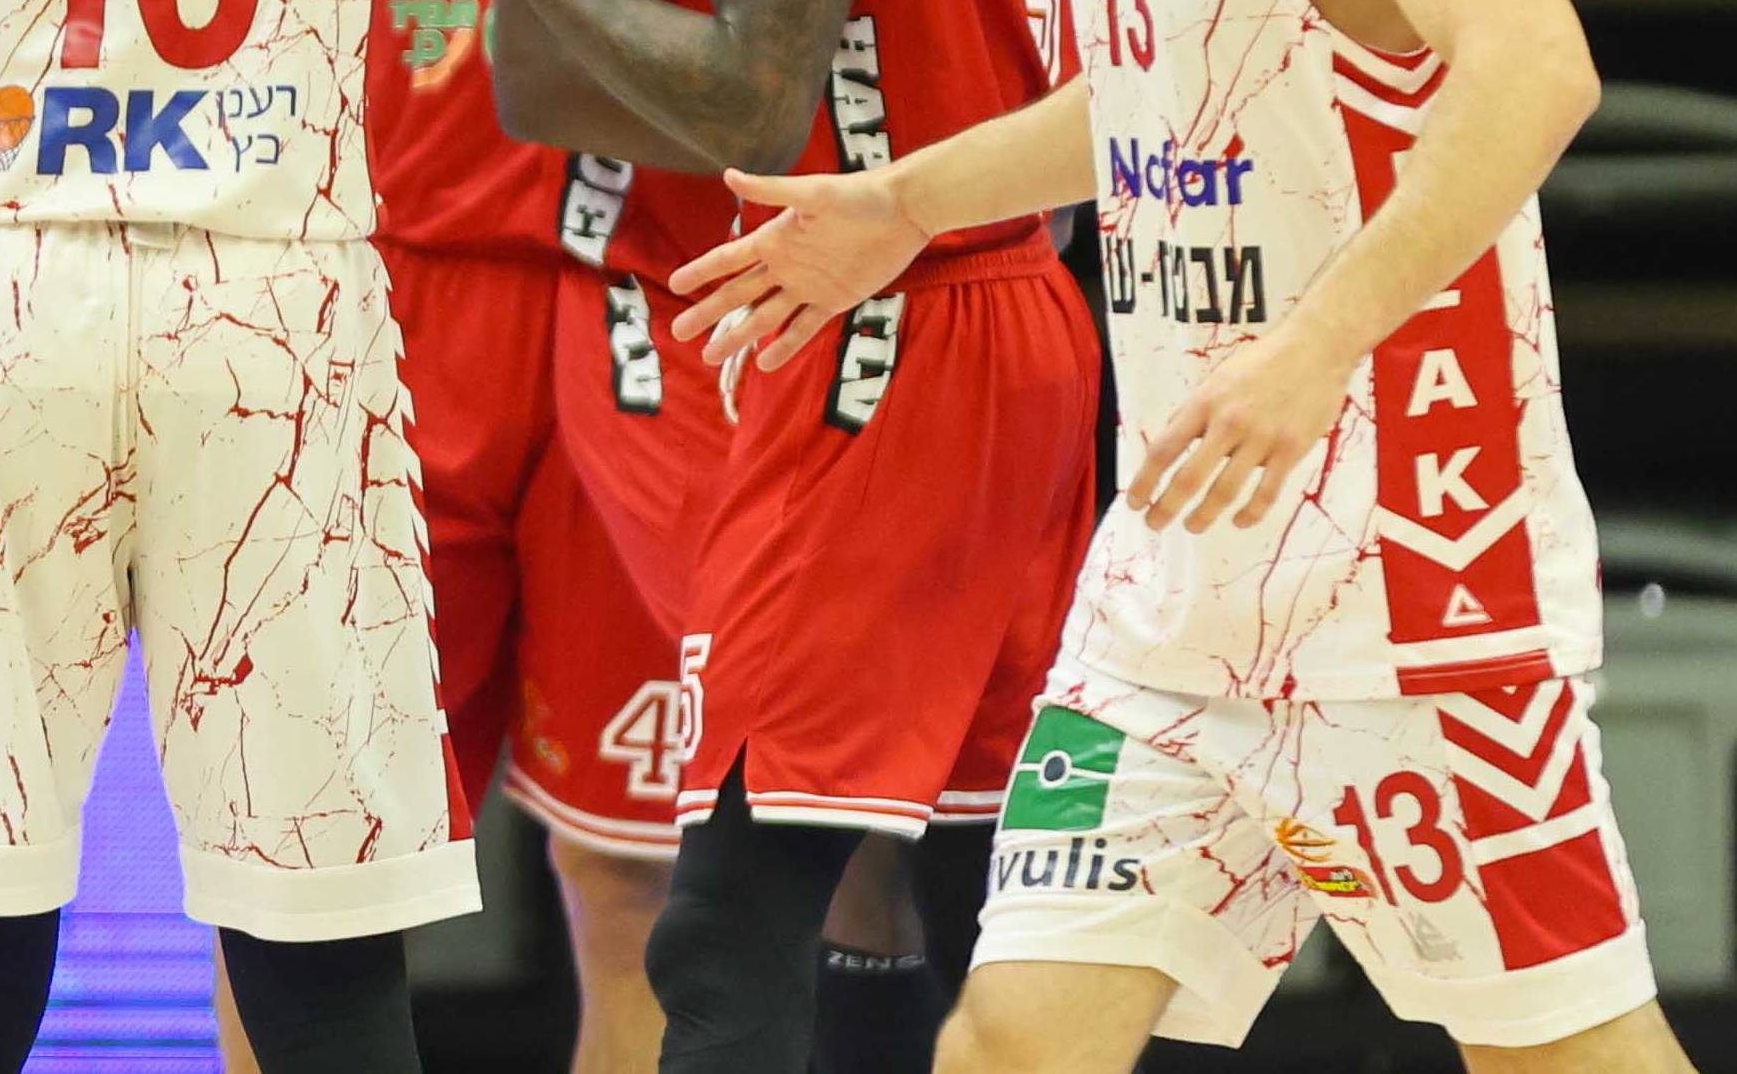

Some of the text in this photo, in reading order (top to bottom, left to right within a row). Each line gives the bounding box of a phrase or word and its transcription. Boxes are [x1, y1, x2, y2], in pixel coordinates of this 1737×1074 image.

[36, 86, 211, 176] RK
[217, 85, 297, 129] רענן
[832, 14, 893, 172] HAP
[232, 133, 281, 173] כץ
[1109, 136, 1254, 207] Nofar
[598, 679, 688, 799] 4
[995, 837, 1141, 892] vulis
[1332, 769, 1464, 907] 13
